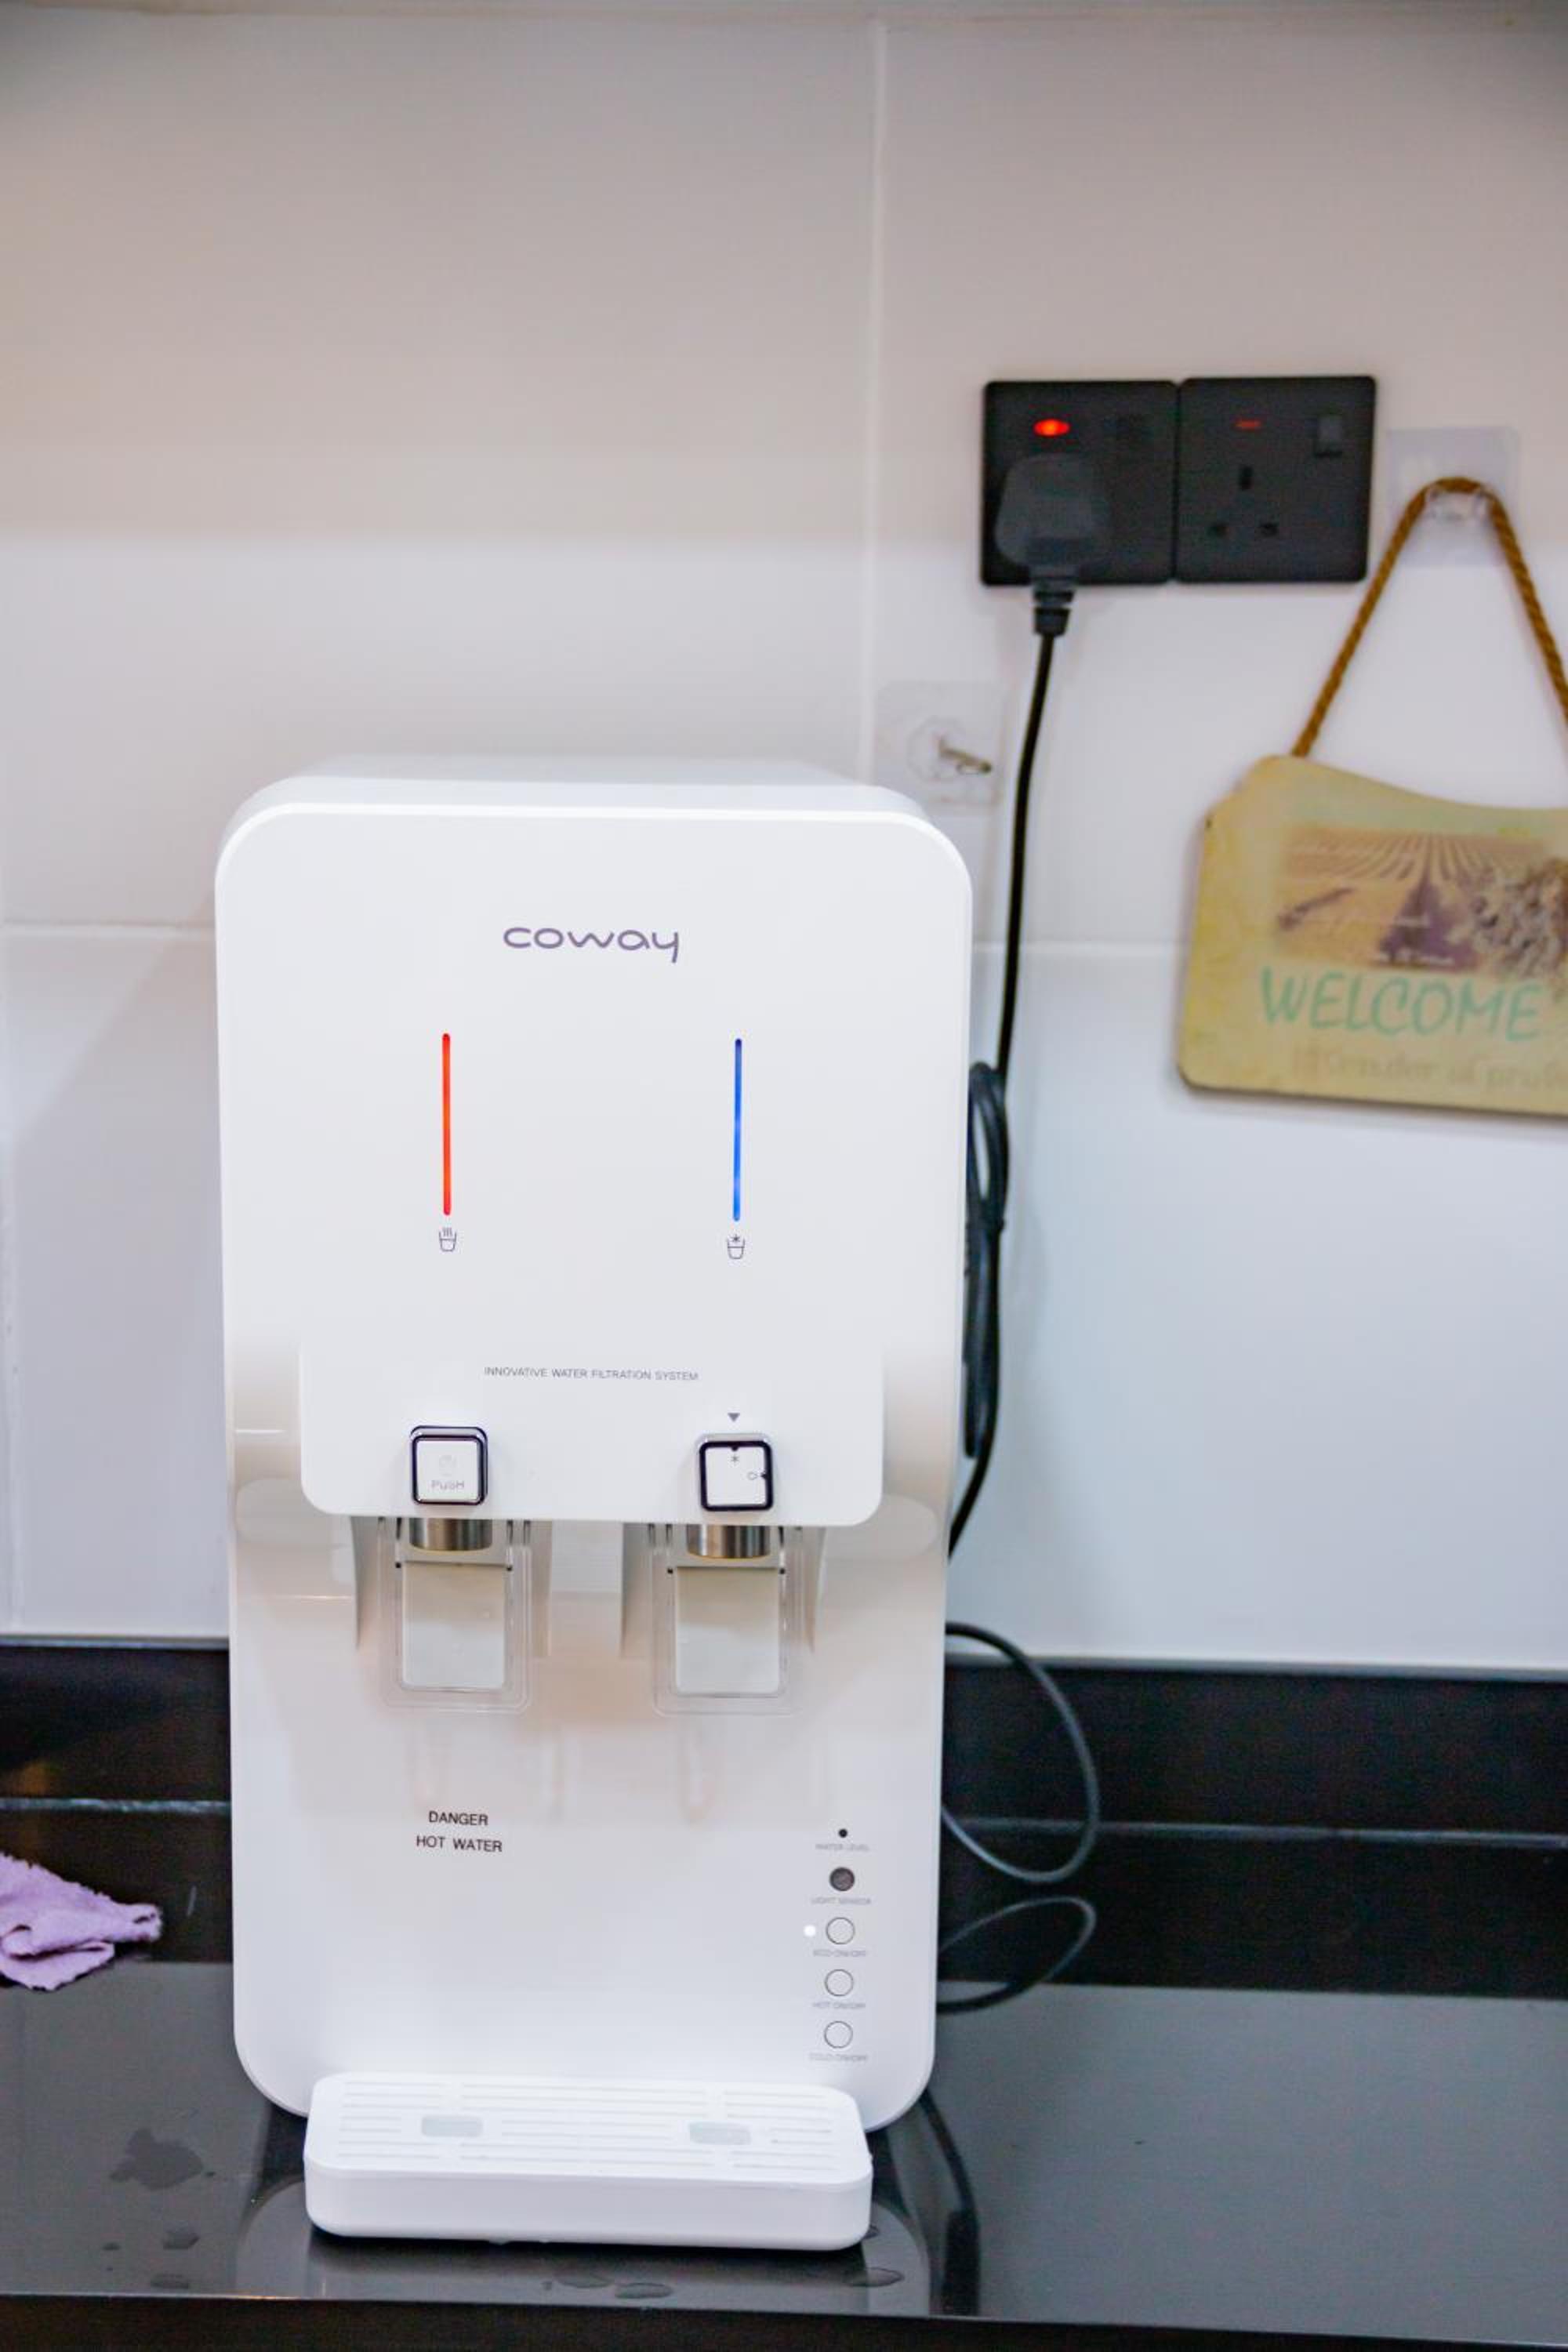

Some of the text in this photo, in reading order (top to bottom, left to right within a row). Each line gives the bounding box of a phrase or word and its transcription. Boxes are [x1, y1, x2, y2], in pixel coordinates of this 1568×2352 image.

[503, 927, 679, 963] coway
[1258, 965, 1543, 1042] WELCOME
[484, 1367, 699, 1381] INNOVATIVE WATER FILTRATION SYSTEM
[428, 1810, 488, 1825] DANGER
[416, 1835, 503, 1852] HOT WATER
